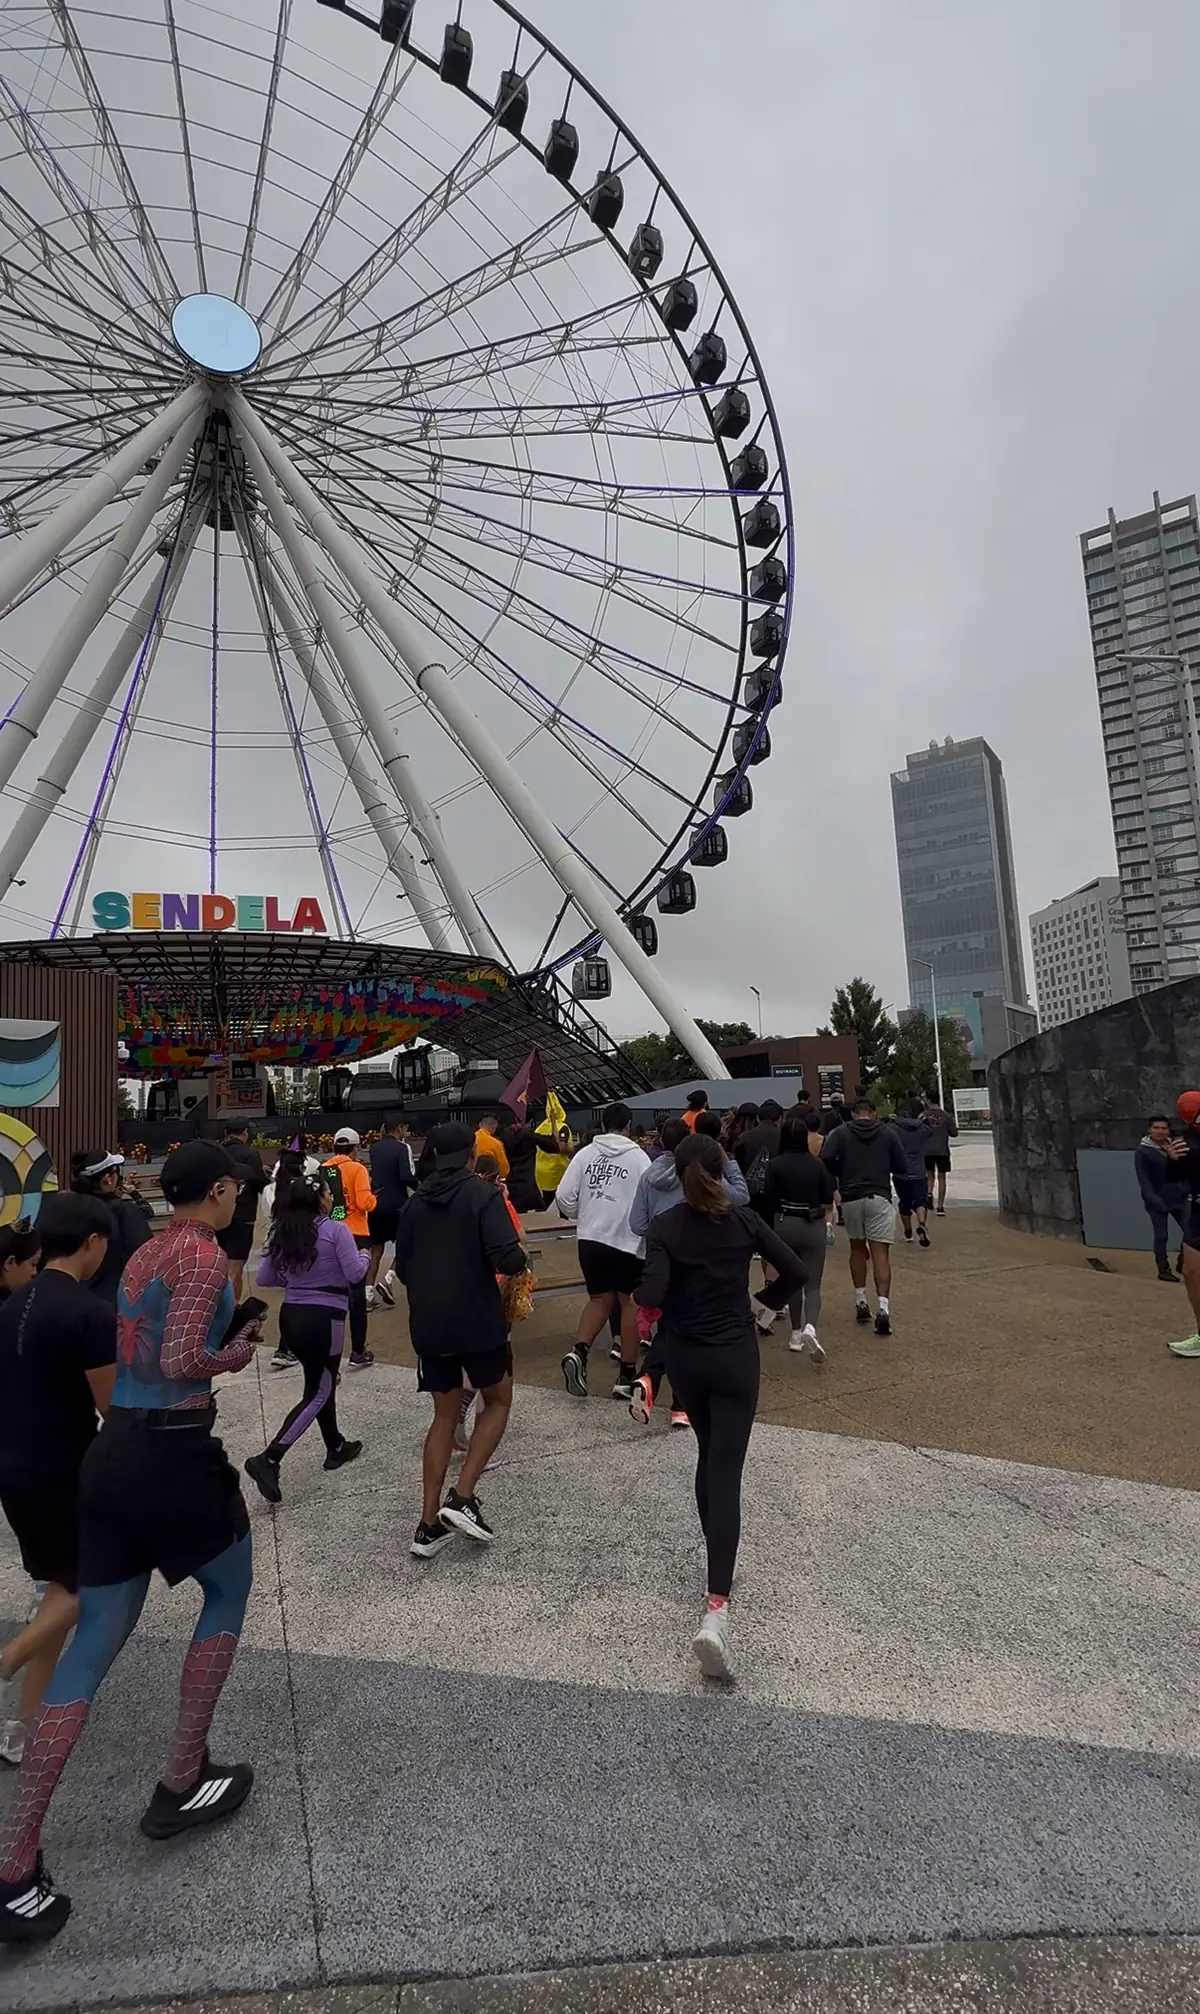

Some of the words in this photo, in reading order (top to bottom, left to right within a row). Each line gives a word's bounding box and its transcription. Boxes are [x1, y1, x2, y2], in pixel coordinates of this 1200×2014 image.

[92, 891, 328, 932] SENDELA
[584, 1163, 629, 1180] ATHLETIC
[589, 1174, 612, 1185] DEPT.
